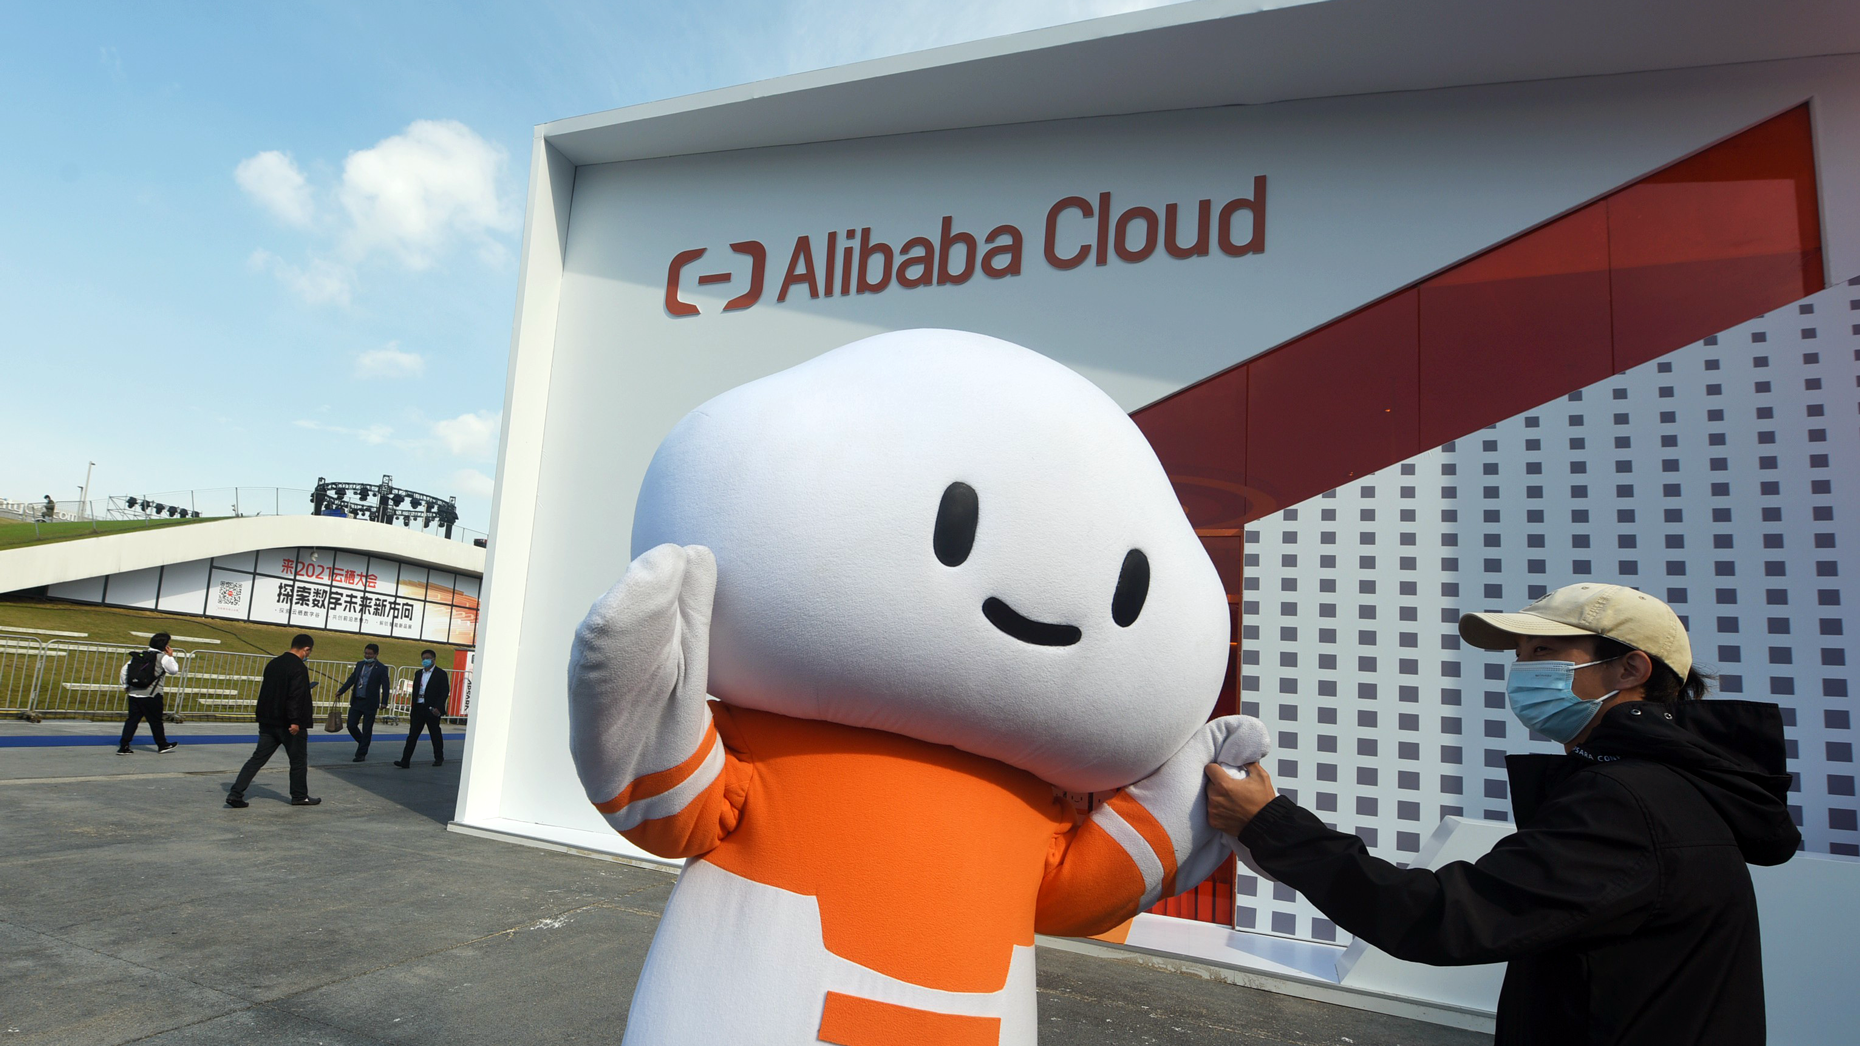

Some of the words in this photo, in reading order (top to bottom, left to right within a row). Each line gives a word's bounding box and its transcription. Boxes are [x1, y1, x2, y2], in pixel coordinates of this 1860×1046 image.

[776, 215, 1023, 302] Alibaba
[1043, 175, 1267, 270] Cloud
[281, 558, 378, 588] 来2021云栖大会
[276, 582, 414, 621] 探索数字未来新方向
